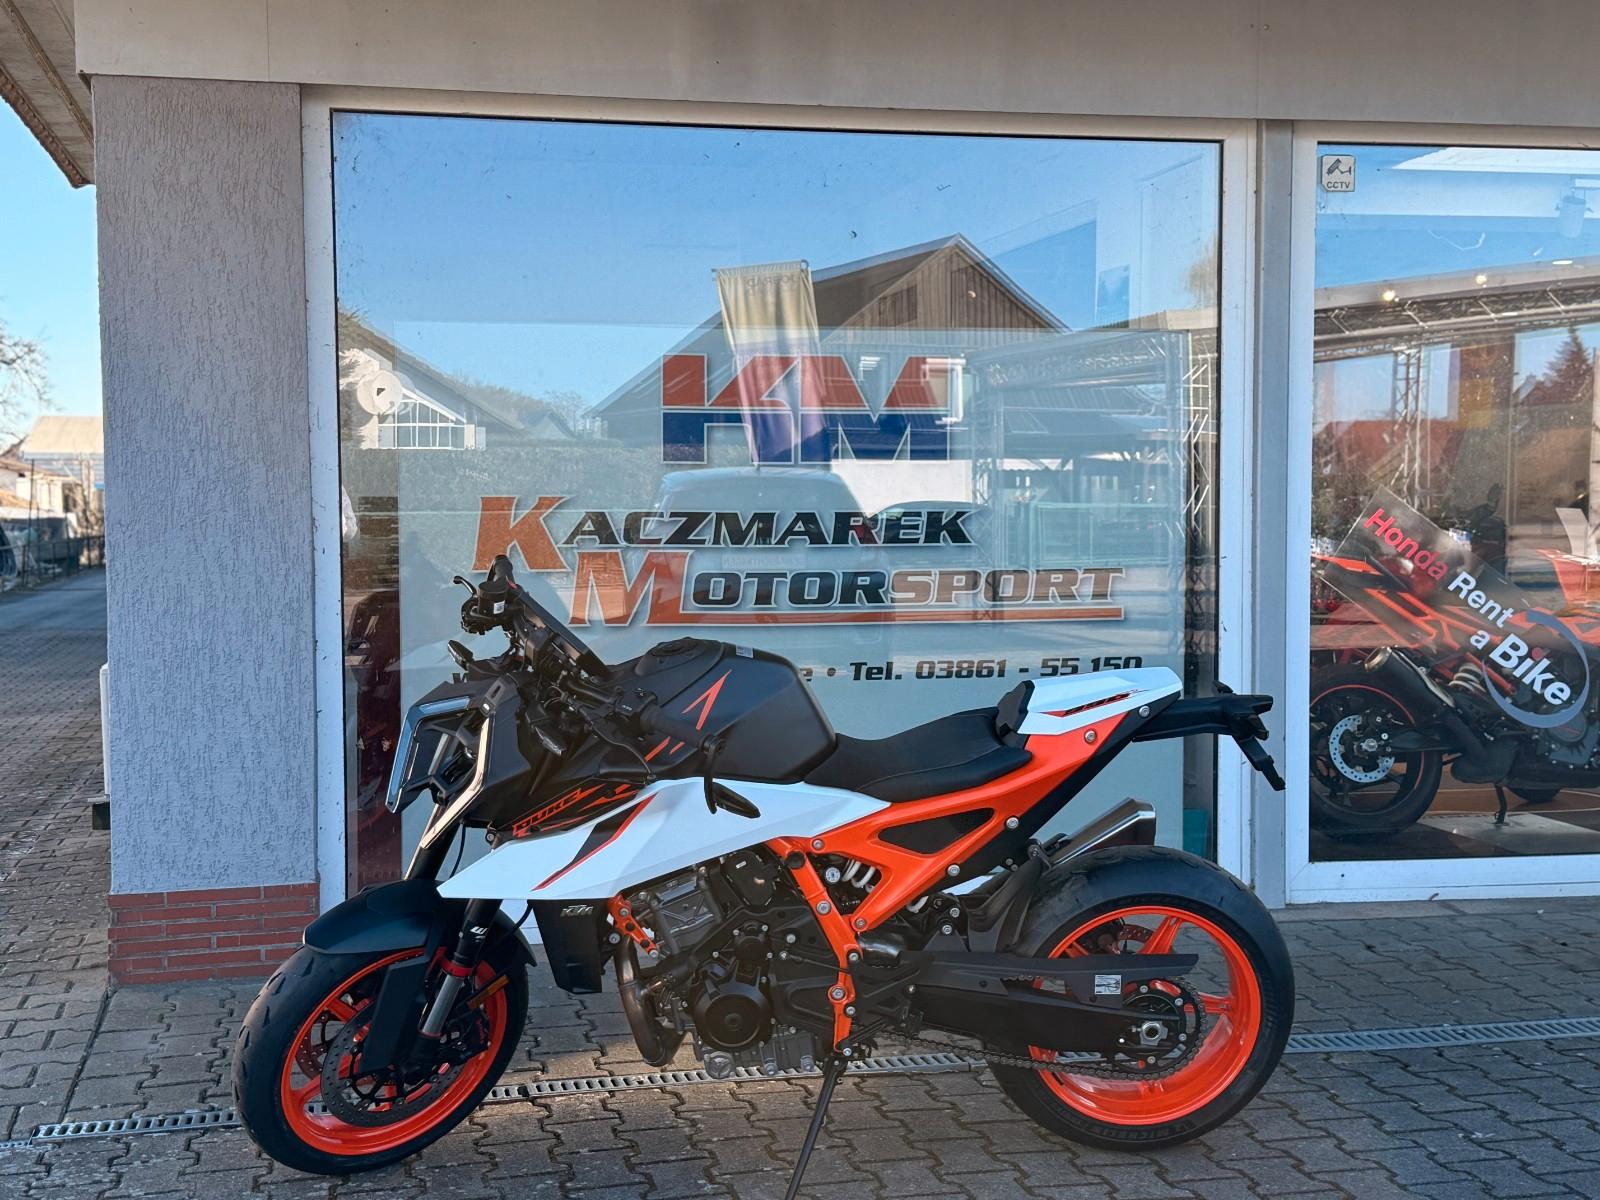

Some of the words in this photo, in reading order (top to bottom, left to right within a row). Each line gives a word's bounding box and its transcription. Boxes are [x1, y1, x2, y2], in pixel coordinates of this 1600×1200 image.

[1326, 181, 1351, 189] CCTV
[661, 353, 951, 465] KM
[471, 495, 977, 573] KACZMAREK
[1362, 507, 1448, 580] Honda
[1447, 571, 1514, 629] Rent
[568, 549, 1126, 627] MOTORSPORT
[850, 661, 902, 681] Tel.
[914, 659, 1007, 679] 03861
[1039, 657, 1080, 676] 55
[1469, 629, 1490, 650] a
[1488, 633, 1571, 706] Bike
